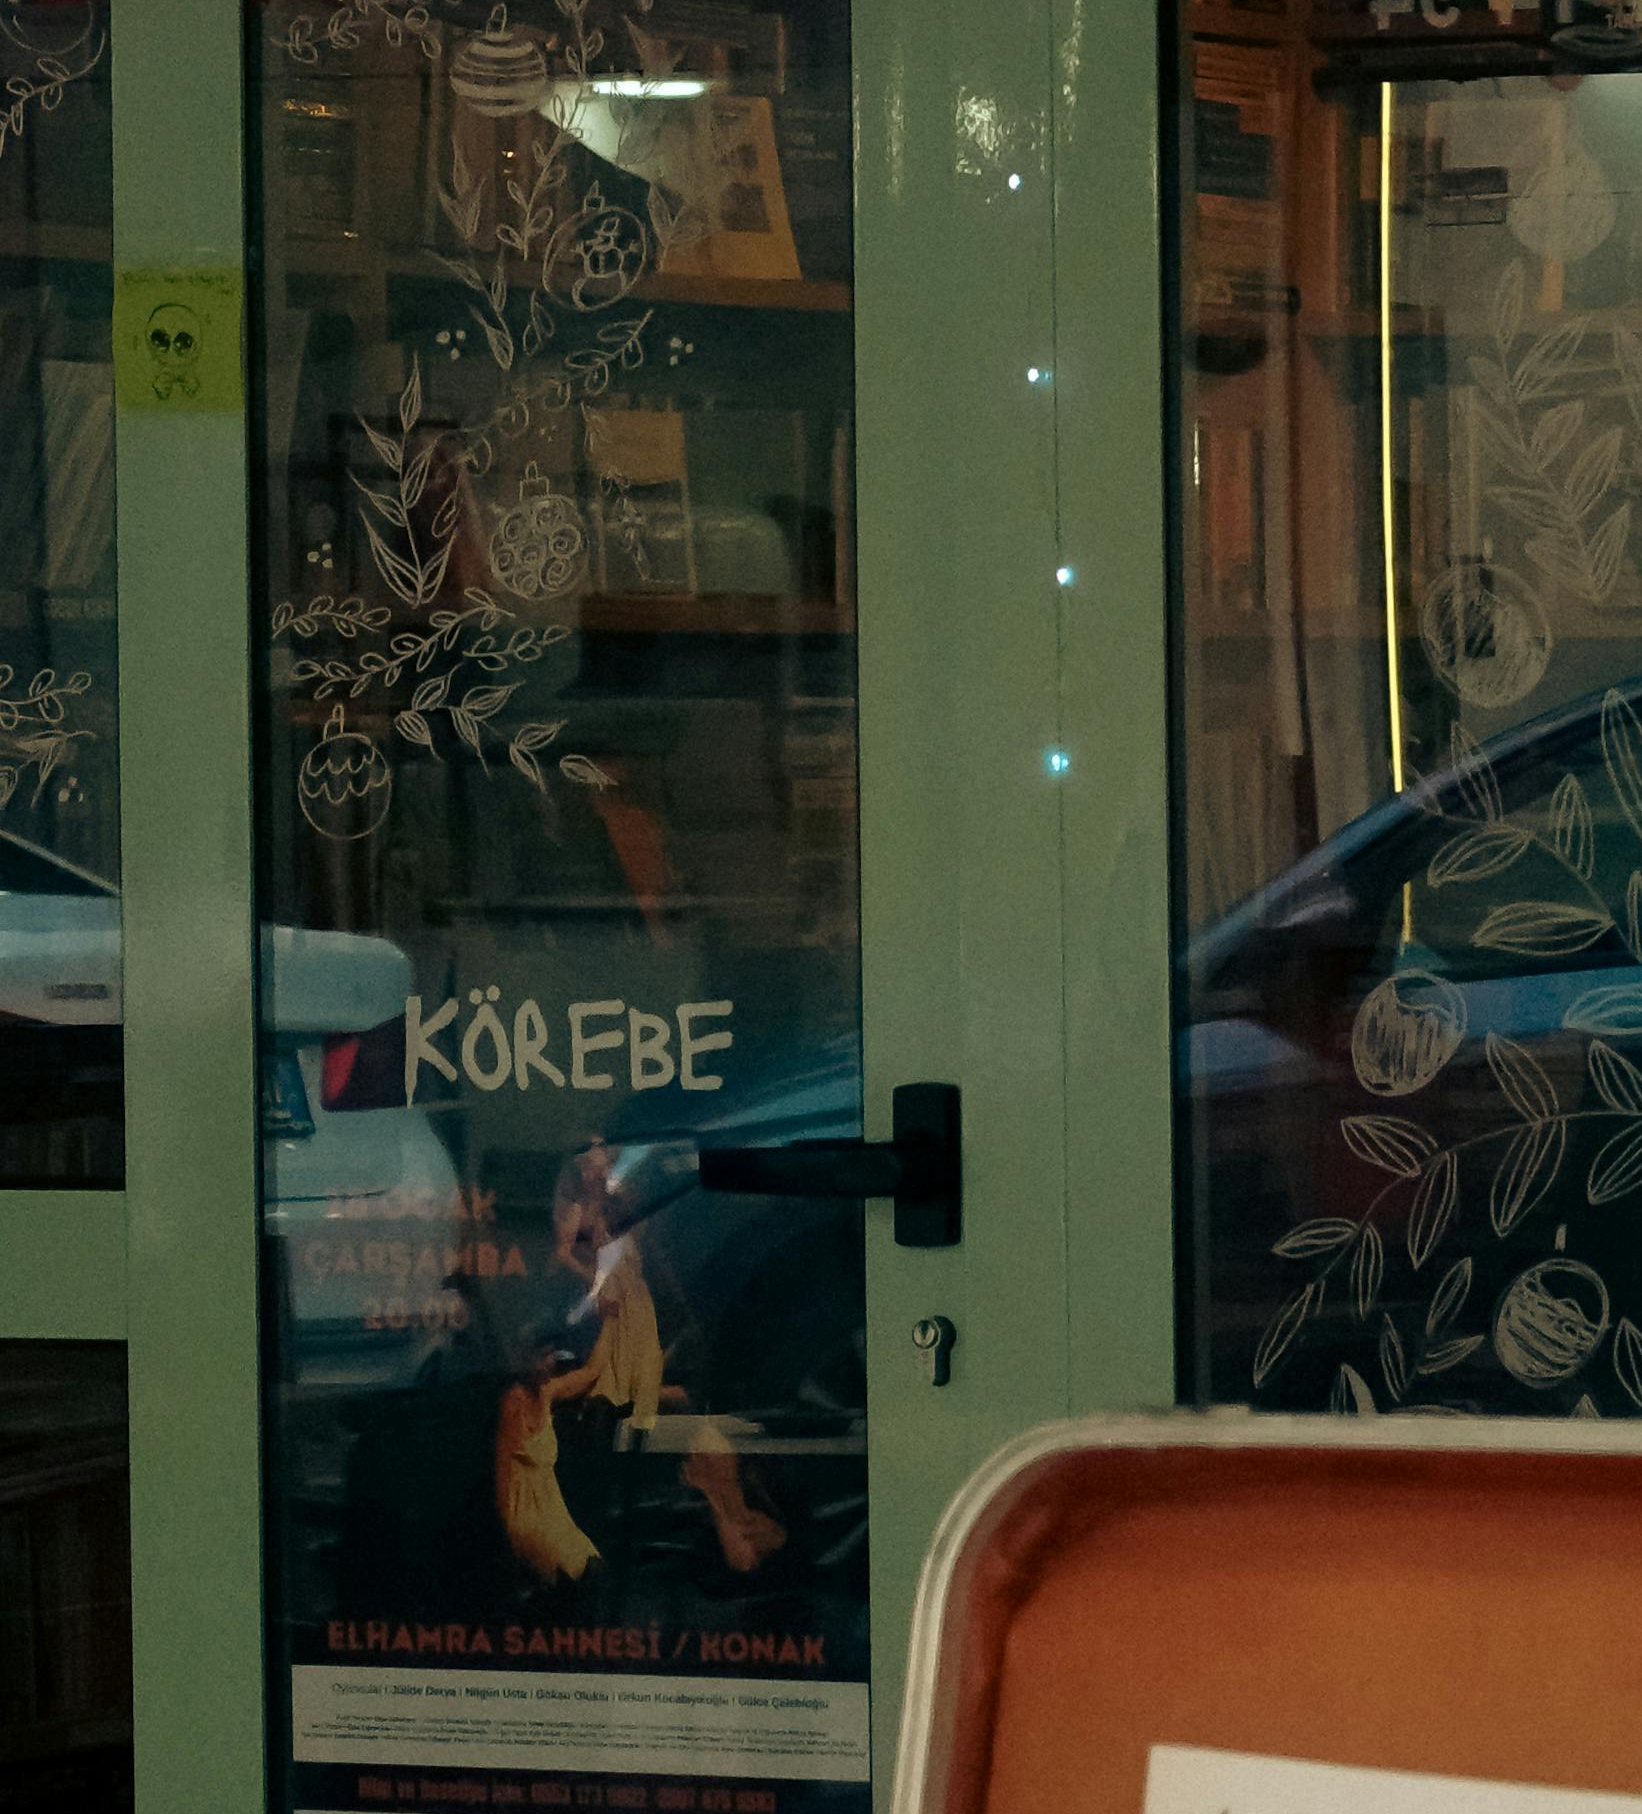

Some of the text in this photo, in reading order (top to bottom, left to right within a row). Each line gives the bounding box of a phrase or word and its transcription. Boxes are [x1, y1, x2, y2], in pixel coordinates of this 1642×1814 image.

[404, 985, 733, 1108] KÖREBE
[327, 1619, 492, 1654] ELHAMRA
[503, 1620, 662, 1660] SAHNESİ
[699, 1633, 825, 1665] KONAK
